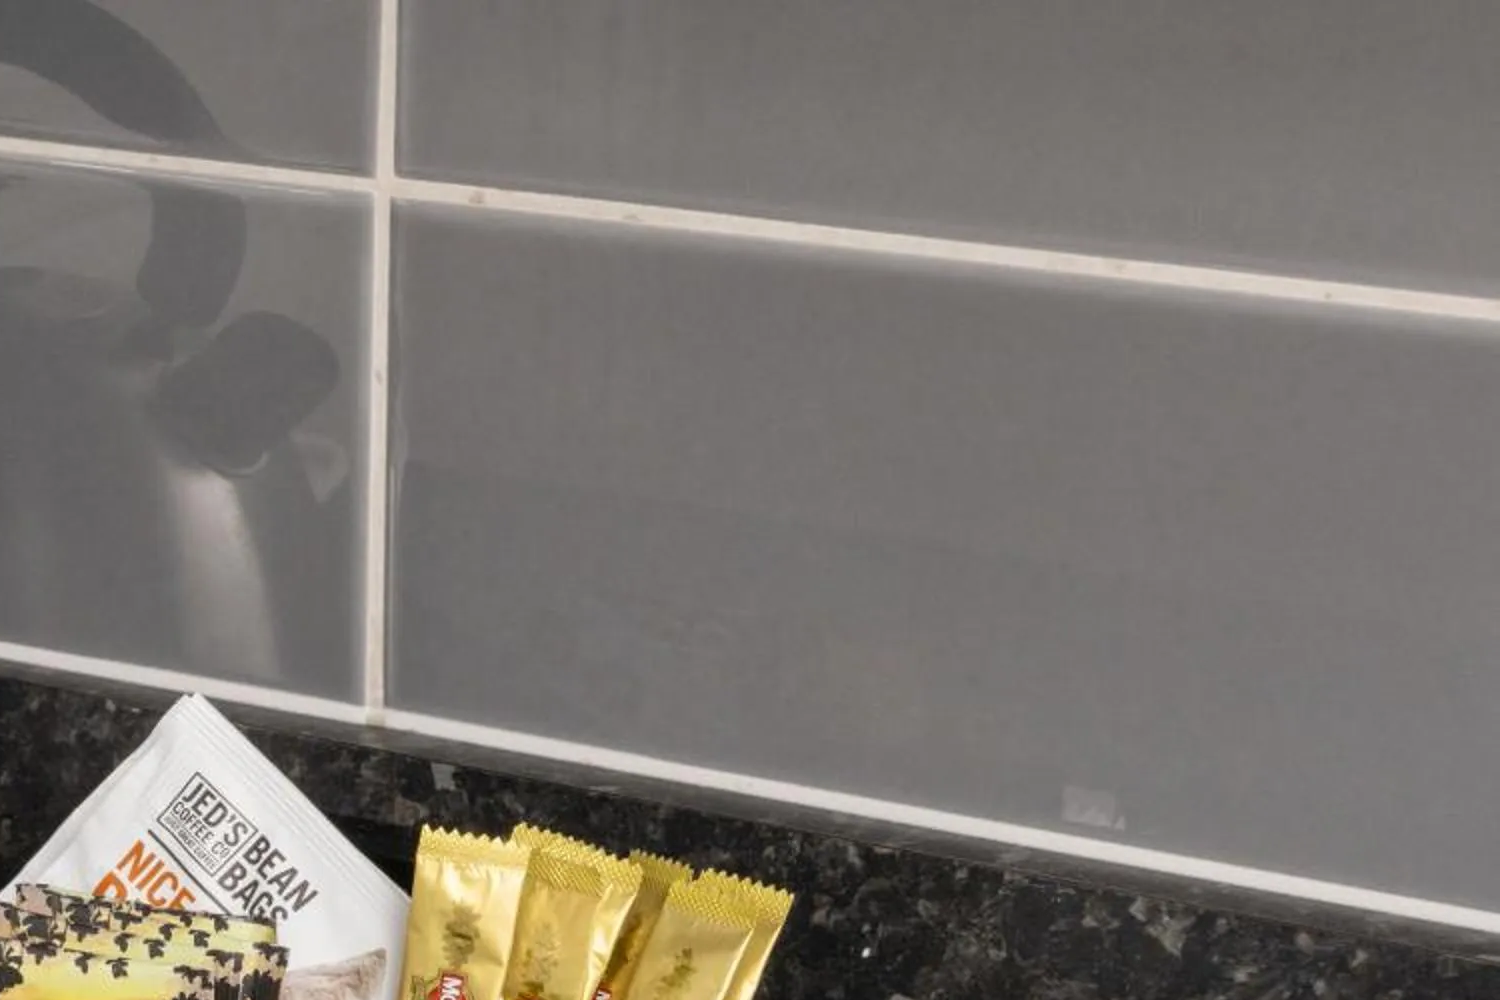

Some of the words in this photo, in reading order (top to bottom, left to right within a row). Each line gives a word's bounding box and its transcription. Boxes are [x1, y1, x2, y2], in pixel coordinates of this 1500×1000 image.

[172, 801, 215, 844] COFFEE
[182, 782, 249, 847] JED'S
[242, 833, 319, 913] BEAN
